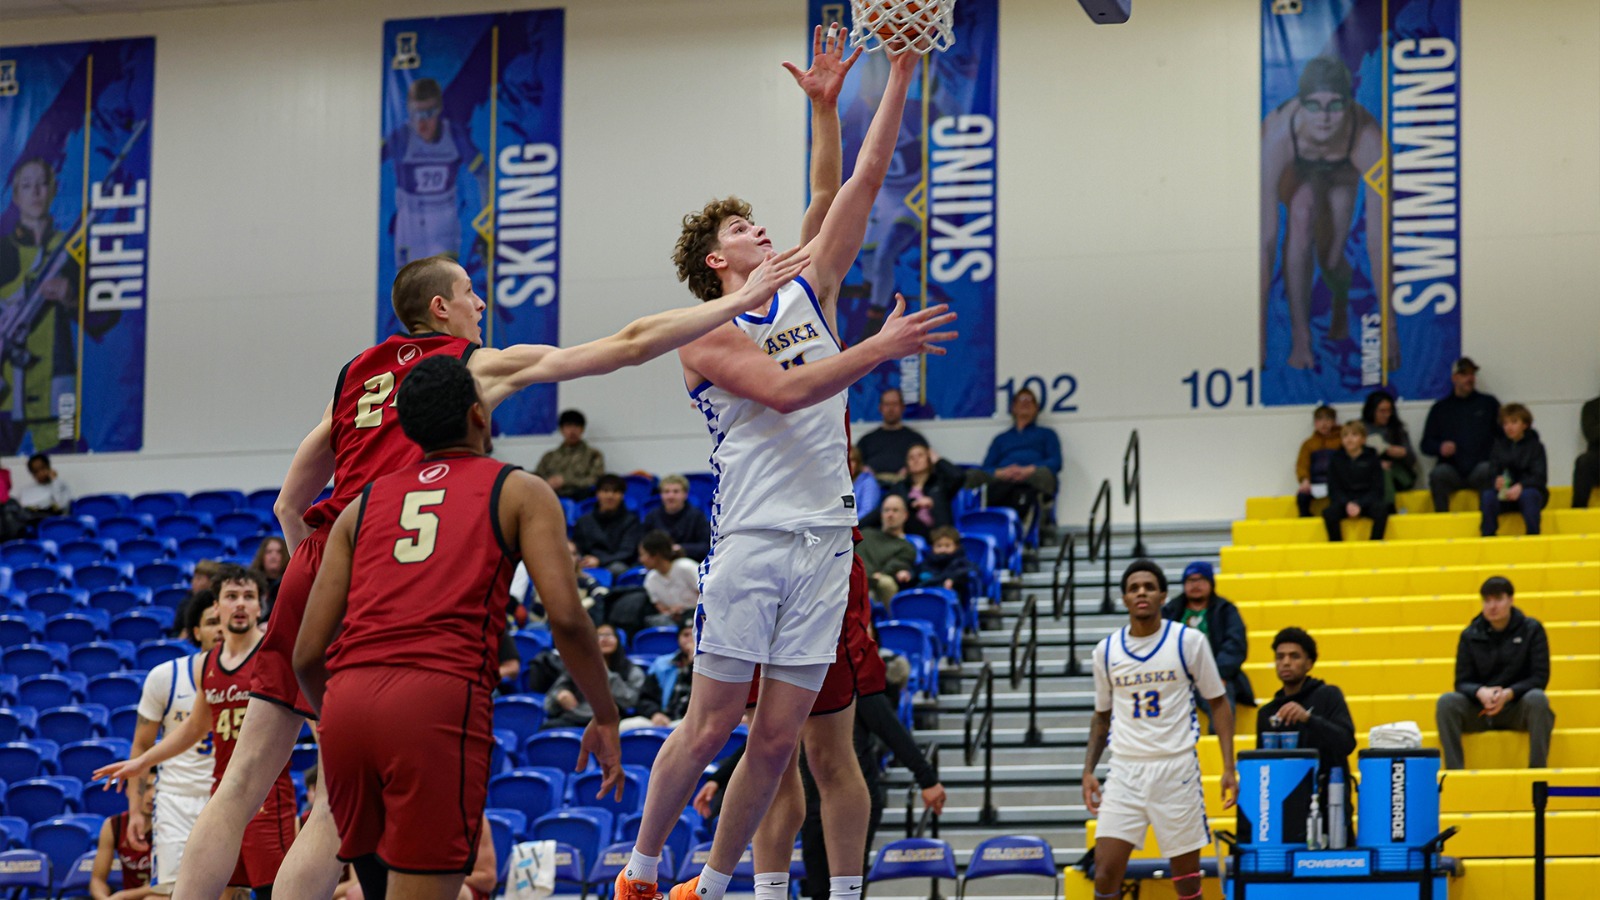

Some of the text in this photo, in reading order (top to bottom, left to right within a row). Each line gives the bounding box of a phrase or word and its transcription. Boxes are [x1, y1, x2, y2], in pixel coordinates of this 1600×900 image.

[930, 114, 994, 283] SKIING
[1392, 37, 1457, 316] SWIMMING
[88, 179, 146, 312] RIFLE
[496, 143, 558, 308] SKIING
[763, 322, 820, 357] ASKA
[354, 371, 397, 429] 2
[997, 373, 1078, 415] 102
[1181, 367, 1254, 409] 101
[392, 488, 447, 565] 5
[226, 684, 250, 702] Coa
[1115, 670, 1177, 687] ALASKA
[1131, 688, 1162, 719] 13
[216, 707, 248, 742] 45
[1259, 764, 1270, 842] POWERADE
[1391, 762, 1405, 839] POWERADE
[1297, 858, 1366, 868] POWERADE
